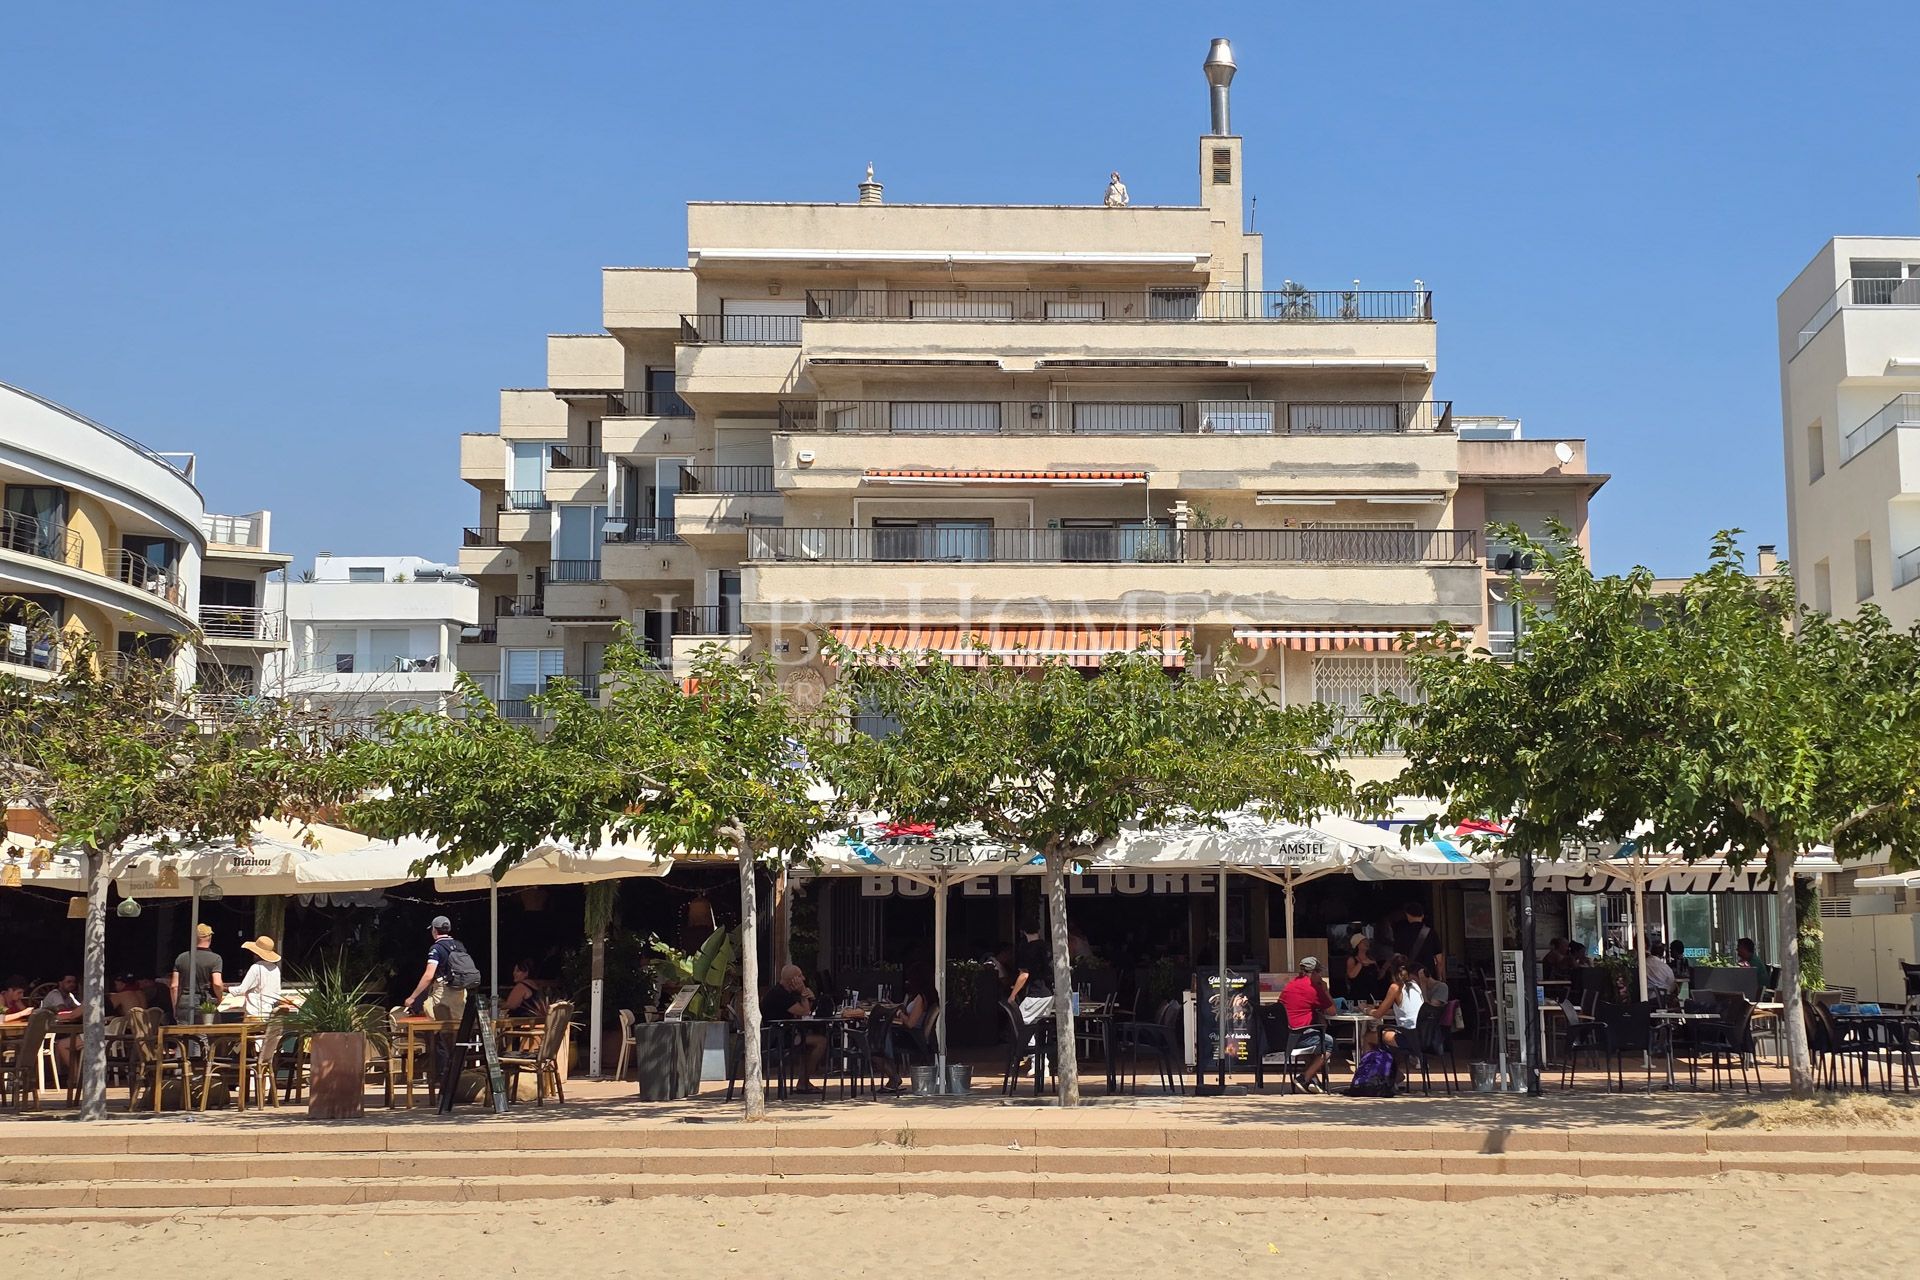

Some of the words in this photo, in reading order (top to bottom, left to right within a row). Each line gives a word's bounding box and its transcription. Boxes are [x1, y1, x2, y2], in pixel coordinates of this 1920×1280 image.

[929, 846, 1021, 863] SILVER
[1278, 843, 1327, 855] AMSTEL
[233, 856, 271, 867] Mahou
